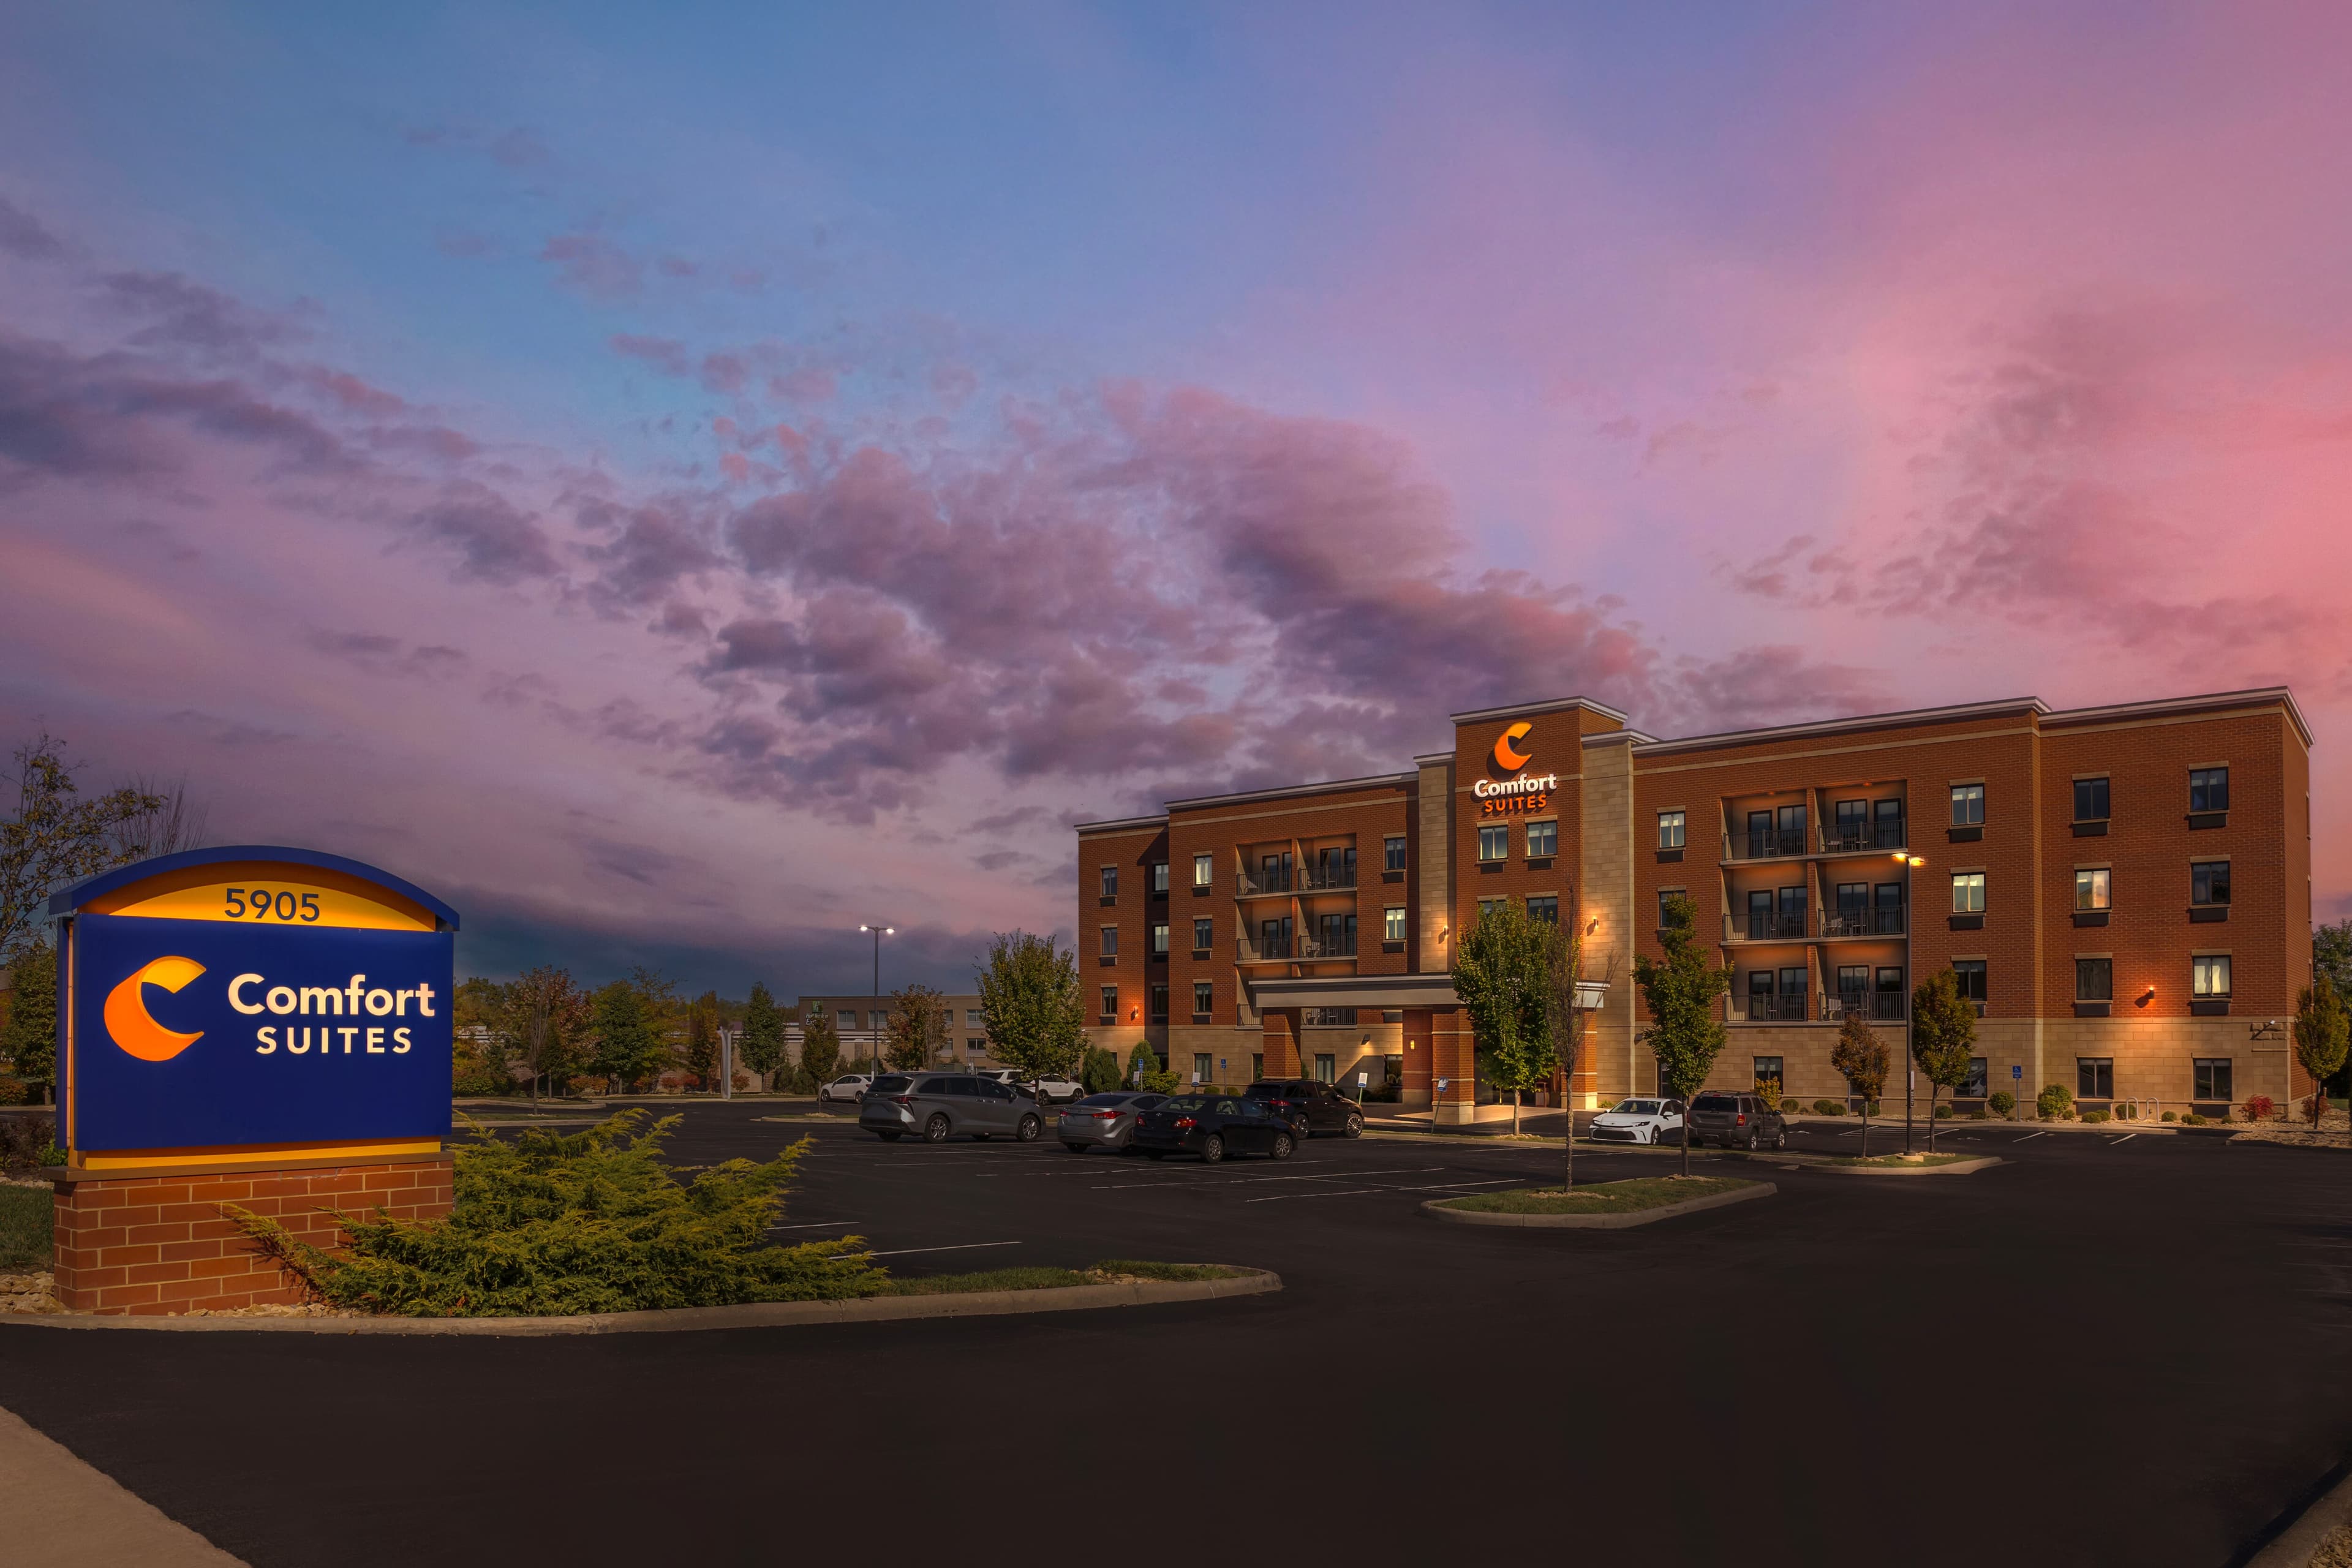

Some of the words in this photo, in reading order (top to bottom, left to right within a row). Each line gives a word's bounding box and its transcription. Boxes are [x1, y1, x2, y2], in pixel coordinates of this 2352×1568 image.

[1474, 774, 1557, 797] Comfort
[1485, 794, 1547, 812] SUITES
[225, 888, 320, 922] 5905
[228, 973, 435, 1017] Comfort
[256, 1027, 411, 1054] SUITES
